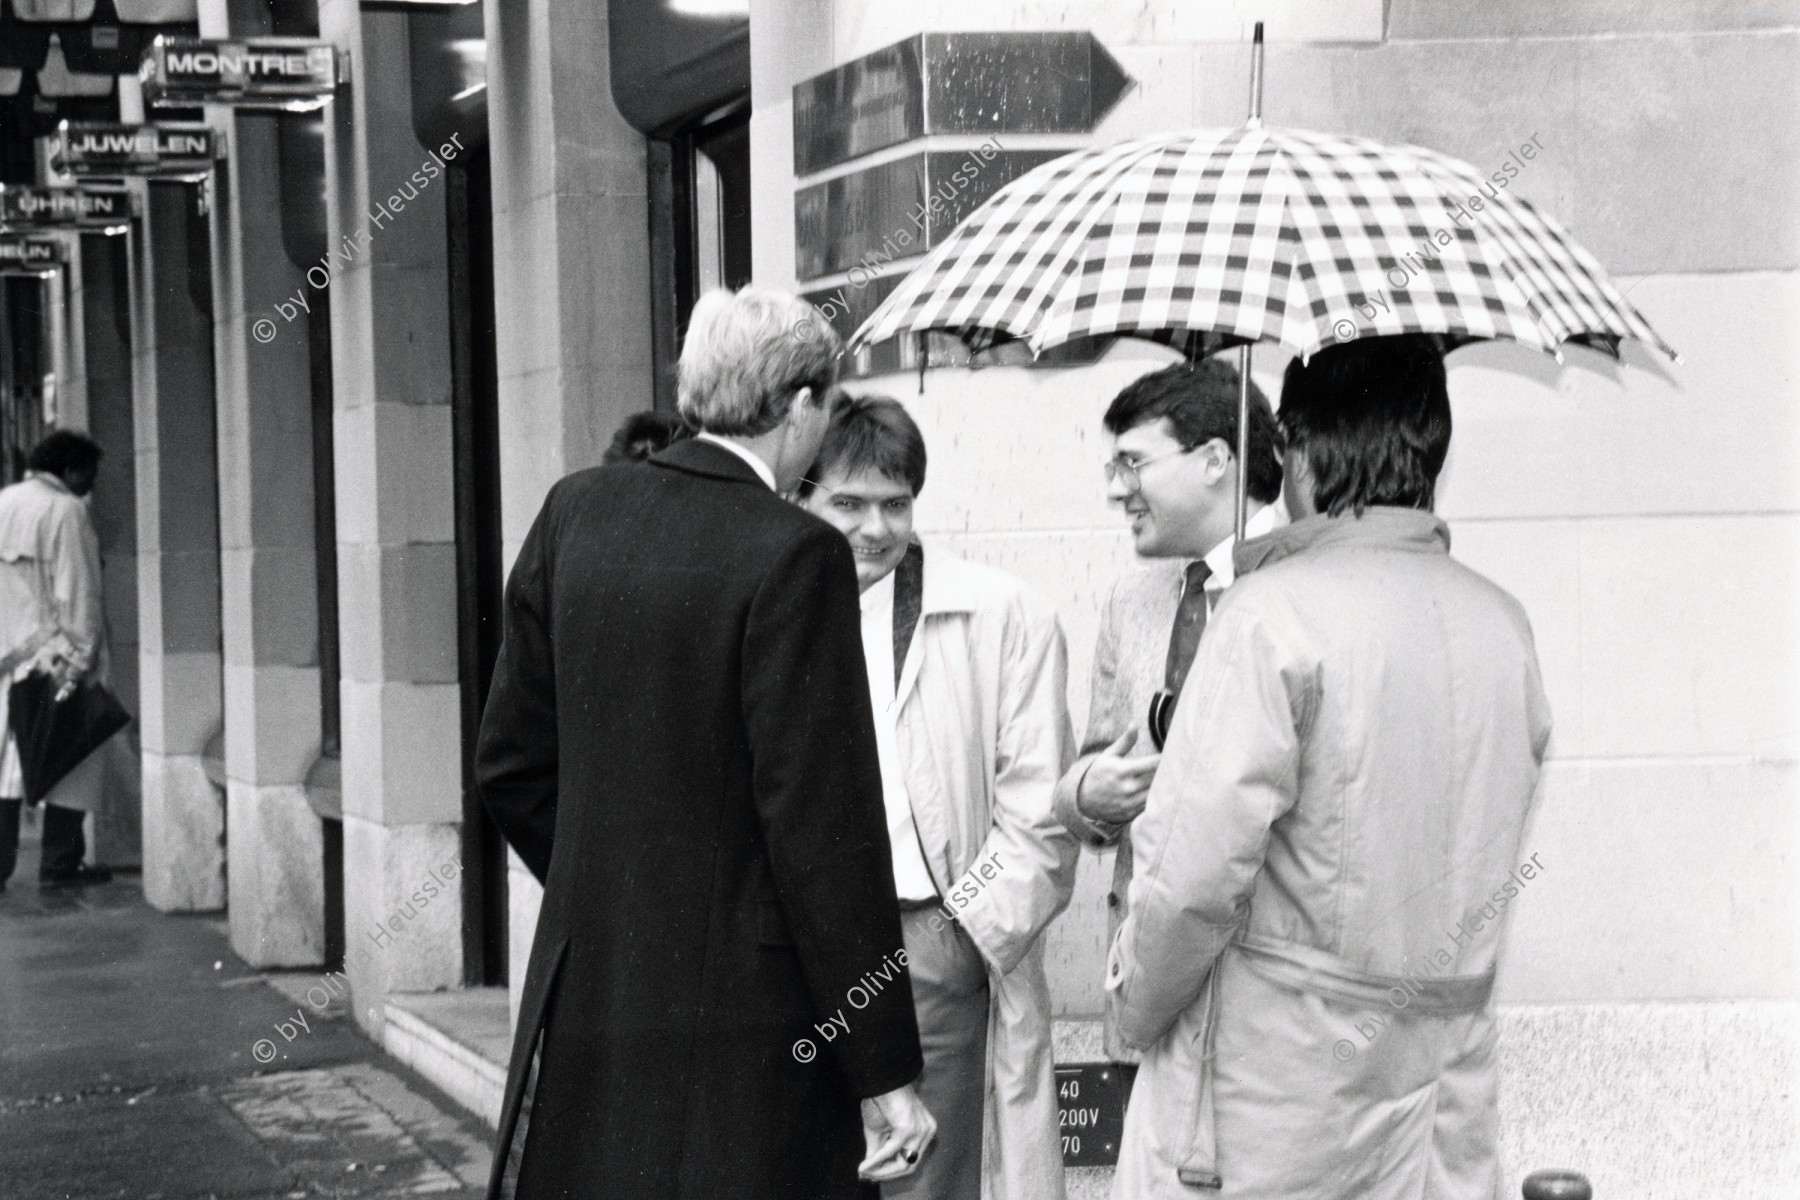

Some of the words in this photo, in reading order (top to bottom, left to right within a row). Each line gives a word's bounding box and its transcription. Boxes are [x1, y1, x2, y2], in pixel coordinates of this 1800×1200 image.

[72, 134, 206, 153] JUWELEN
[19, 196, 113, 213] UHREN
[1060, 1081, 1079, 1098] 40
[1059, 1108, 1099, 1127] 200V
[1061, 1135, 1080, 1154] 70
